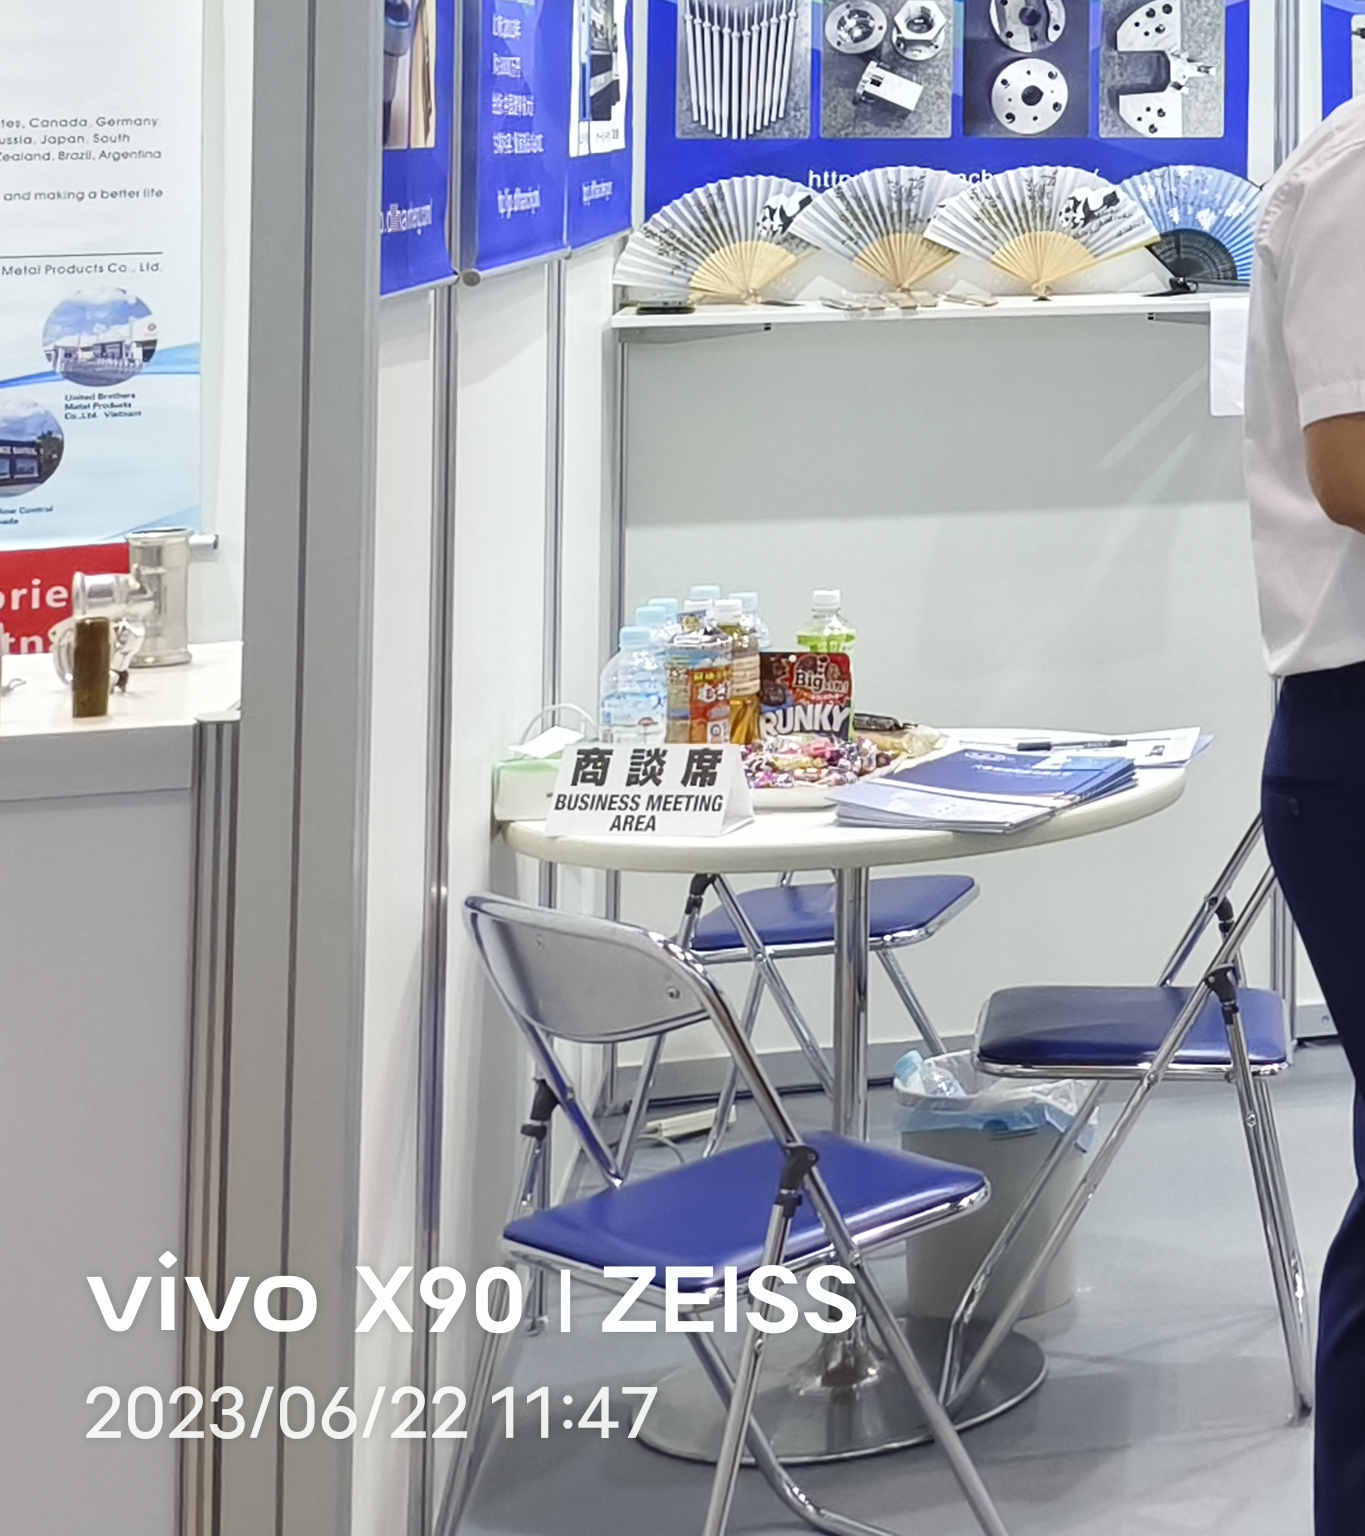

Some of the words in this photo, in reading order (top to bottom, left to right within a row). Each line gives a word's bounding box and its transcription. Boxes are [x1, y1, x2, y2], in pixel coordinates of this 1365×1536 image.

[93, 133, 130, 144] South
[98, 150, 162, 162] Argentina
[3, 191, 31, 201] and
[34, 190, 85, 202] making
[88, 191, 96, 199] a
[100, 189, 140, 199] better
[143, 188, 163, 198] life
[1, 265, 41, 276] Metal
[45, 263, 104, 275] Products
[793, 671, 824, 692] Big
[570, 747, 723, 787] 商談席
[554, 793, 641, 811] BUSINESS
[645, 794, 723, 812] MEETING
[609, 815, 656, 832] AREA
